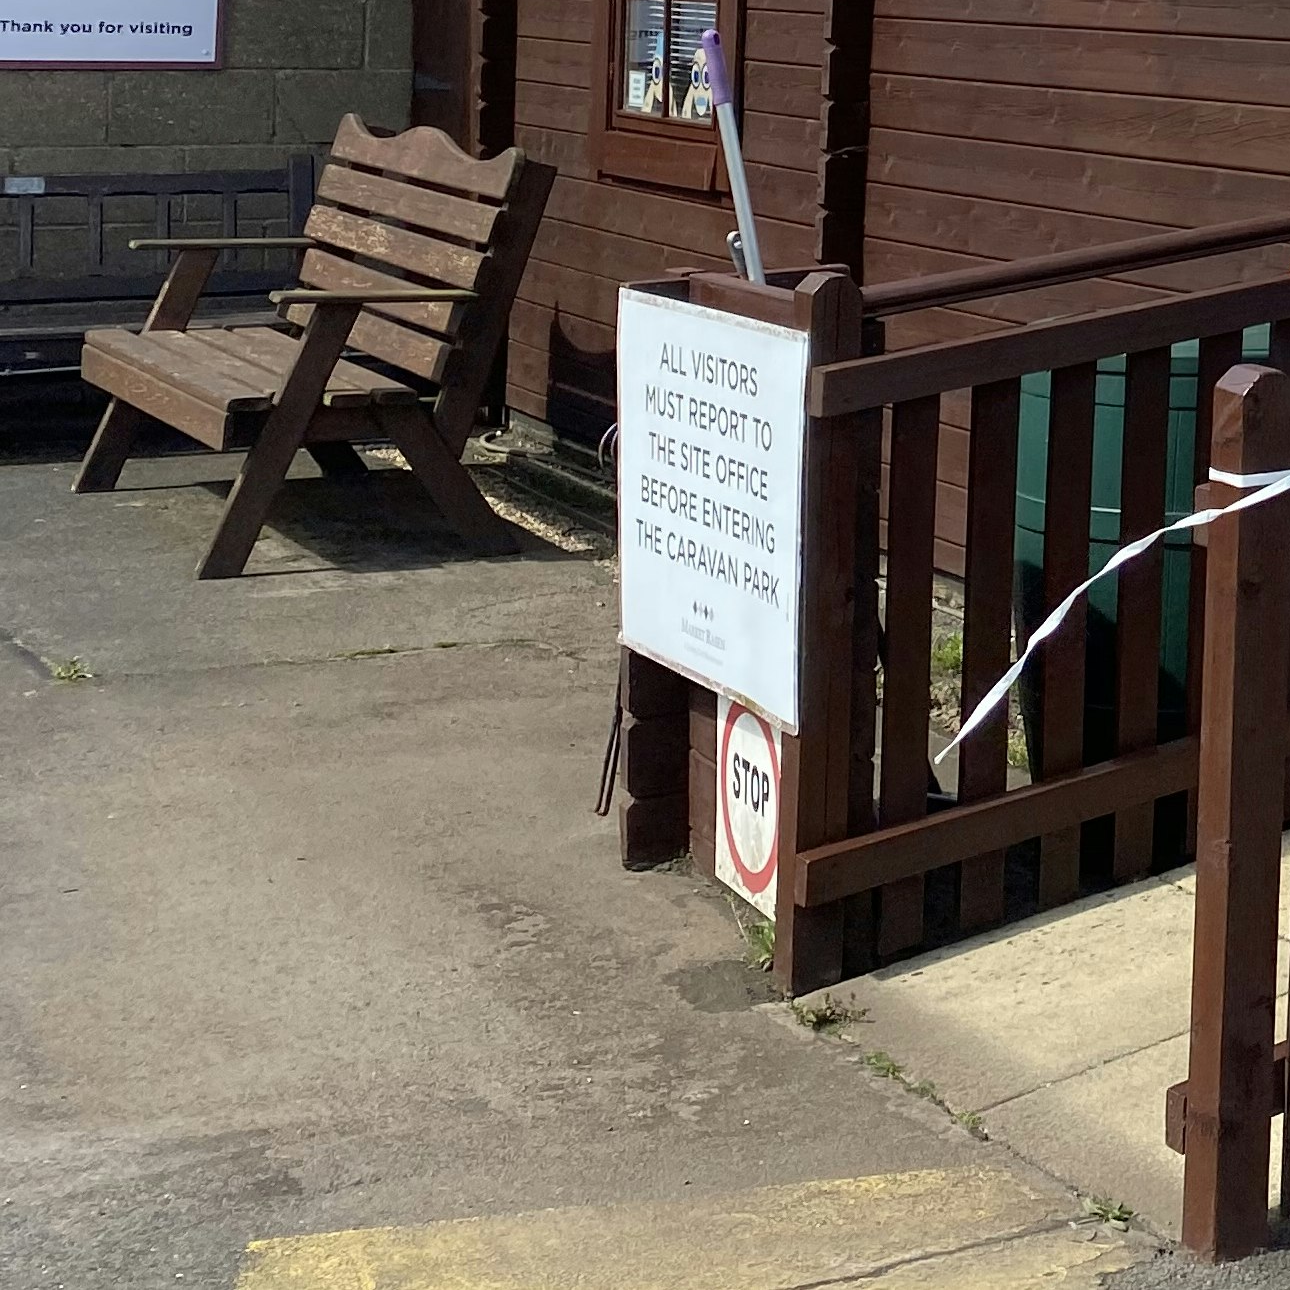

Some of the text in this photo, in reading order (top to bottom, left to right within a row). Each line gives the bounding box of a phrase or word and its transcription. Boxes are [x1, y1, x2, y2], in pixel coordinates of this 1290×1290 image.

[0, 19, 193, 36] Thank you for visiting
[660, 342, 758, 397] ALL VISITORS
[645, 383, 772, 451] MUST REPORT TO
[648, 431, 768, 501] THE SITE OFFICE
[641, 474, 775, 554] BEFORE ENTERING
[636, 518, 780, 609] THE CARAVAN PARK
[733, 752, 769, 817] STOP
